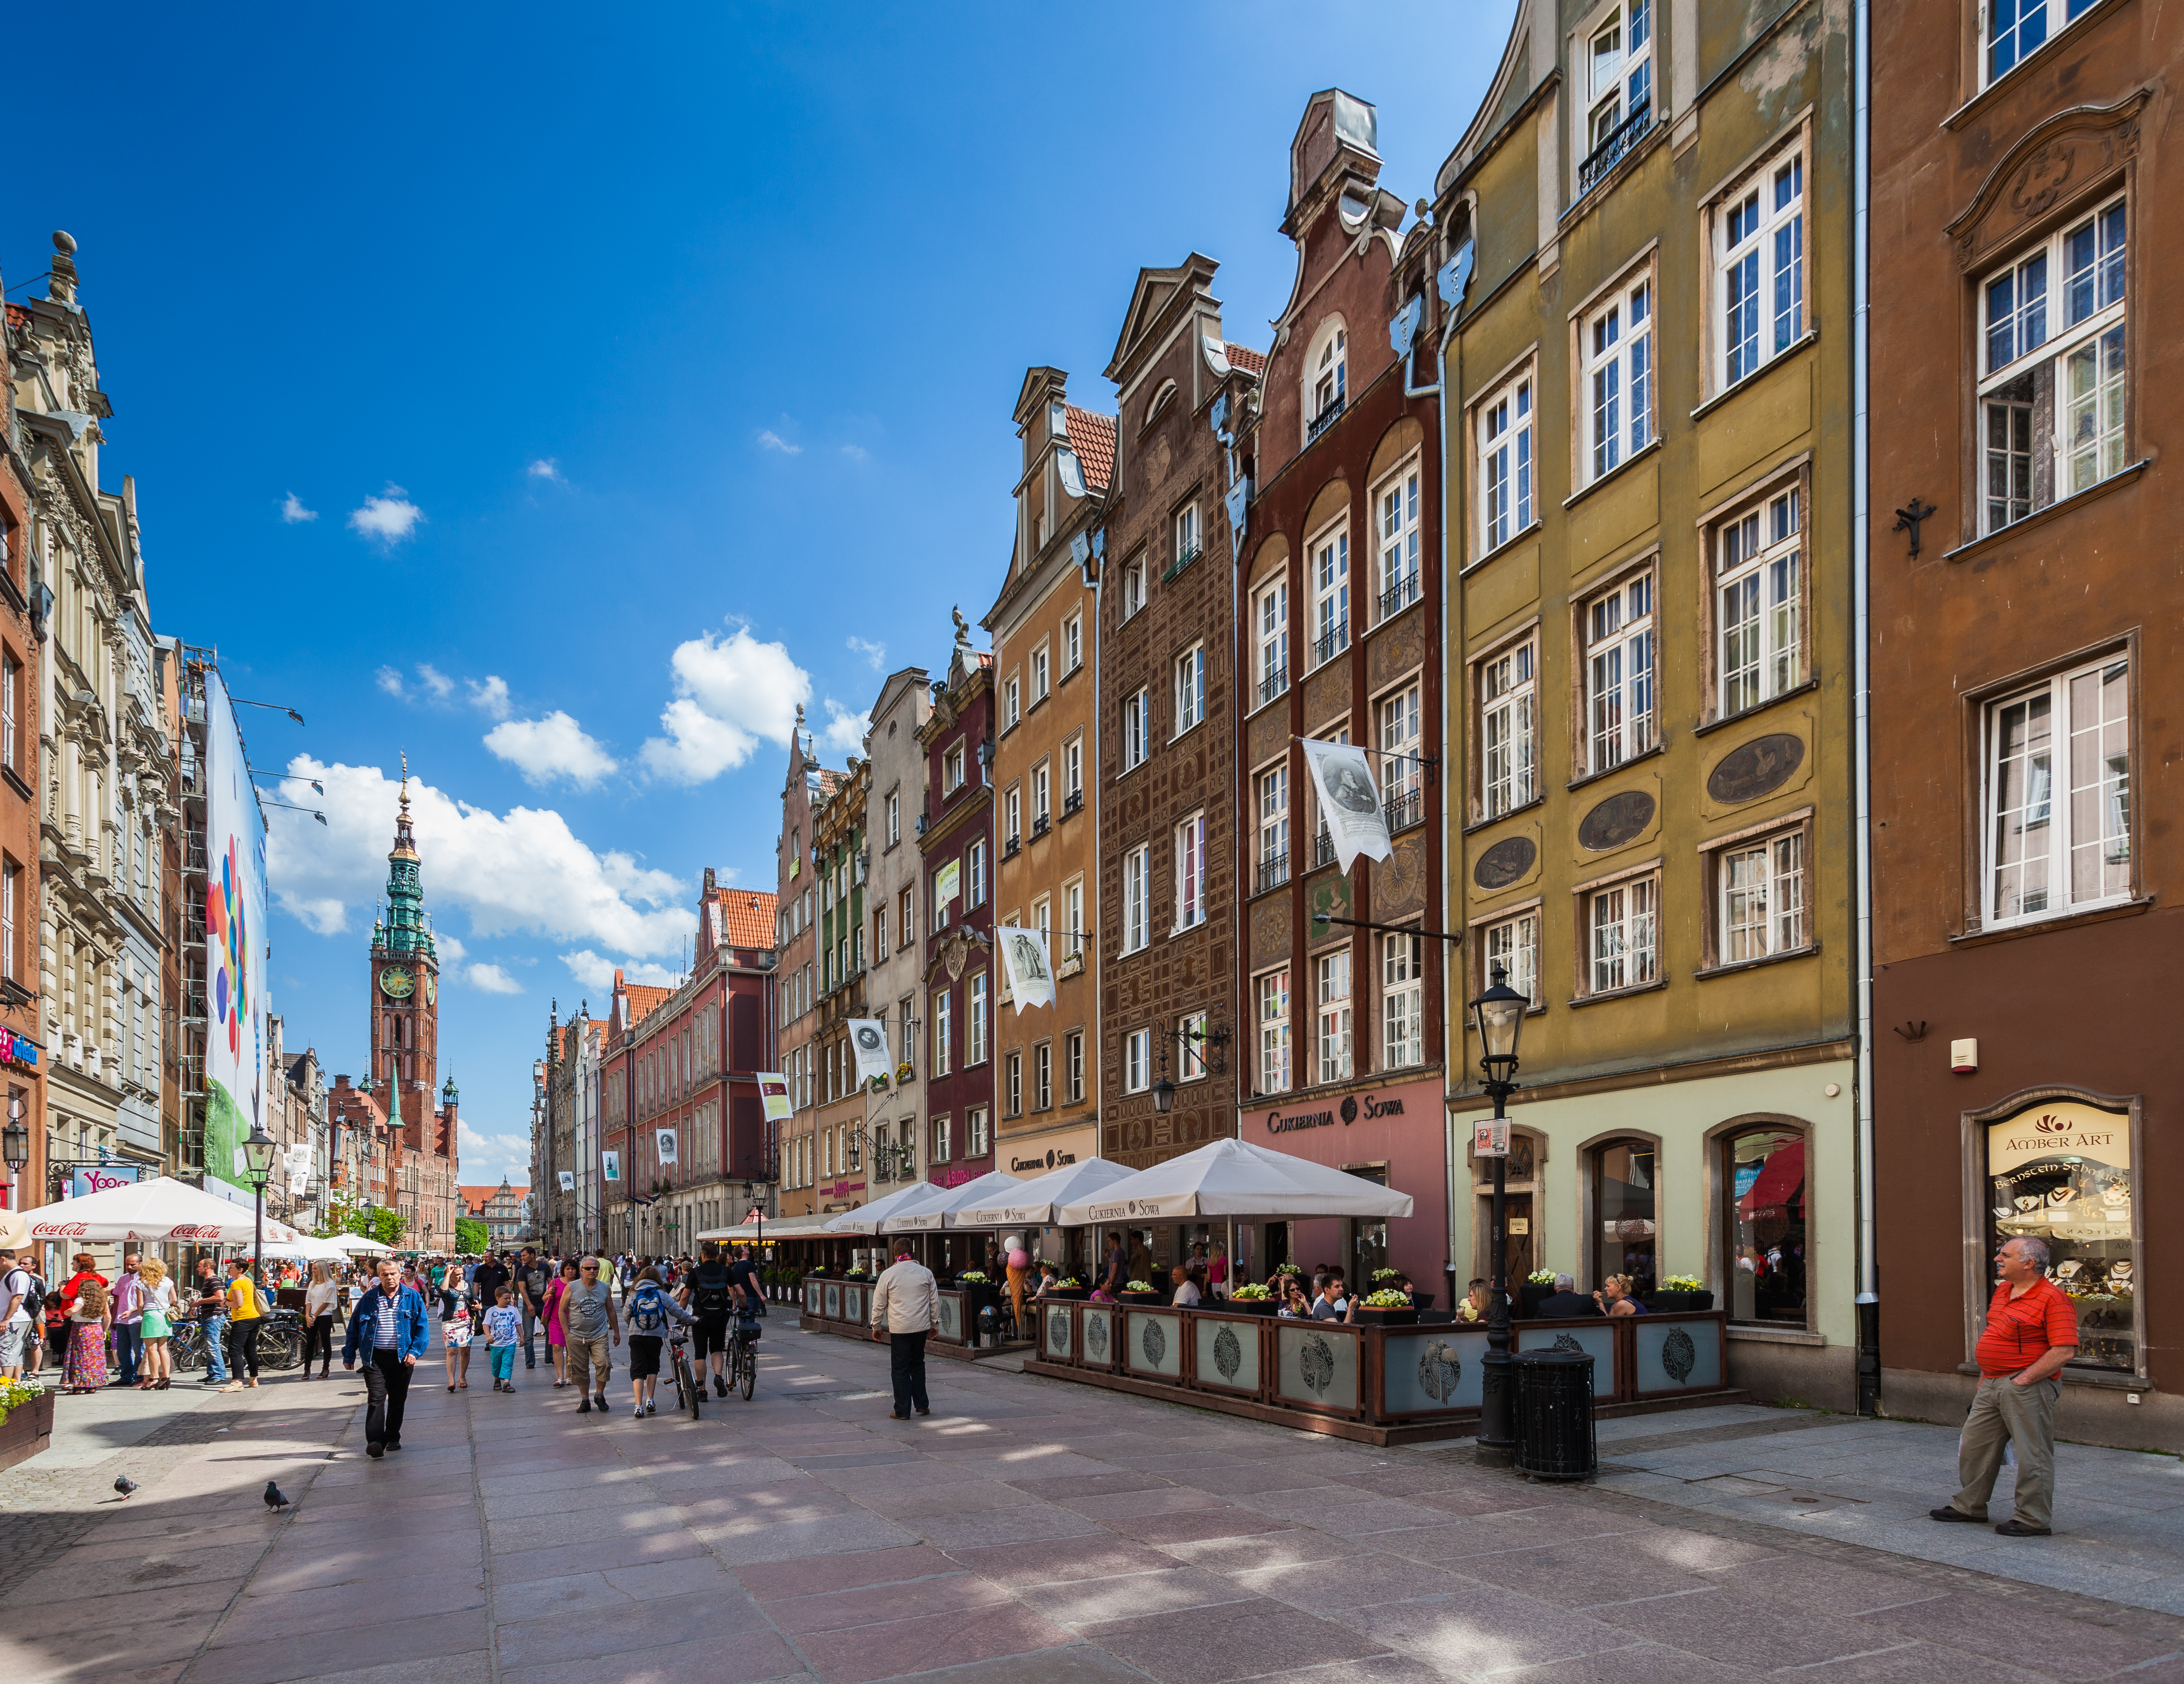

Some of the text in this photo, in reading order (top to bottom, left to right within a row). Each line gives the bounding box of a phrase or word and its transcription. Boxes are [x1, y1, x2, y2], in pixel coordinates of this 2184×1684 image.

[1266, 1095, 1404, 1133] CUKIERNIA SOWA
[2006, 1133, 2114, 1150] AMBER ART
[1011, 1150, 1076, 1171] CUKIERNIA SOWA
[952, 1169, 970, 1185] BUDDHA
[976, 1208, 1026, 1222] CUKIERNIA SOWA
[1089, 1200, 1159, 1220] CUKIERNIA SOWA
[32, 1222, 91, 1235] Coca-Cola
[897, 1216, 927, 1228] CUKIERNIA SOWA
[170, 1224, 224, 1238] Coca-Cola
